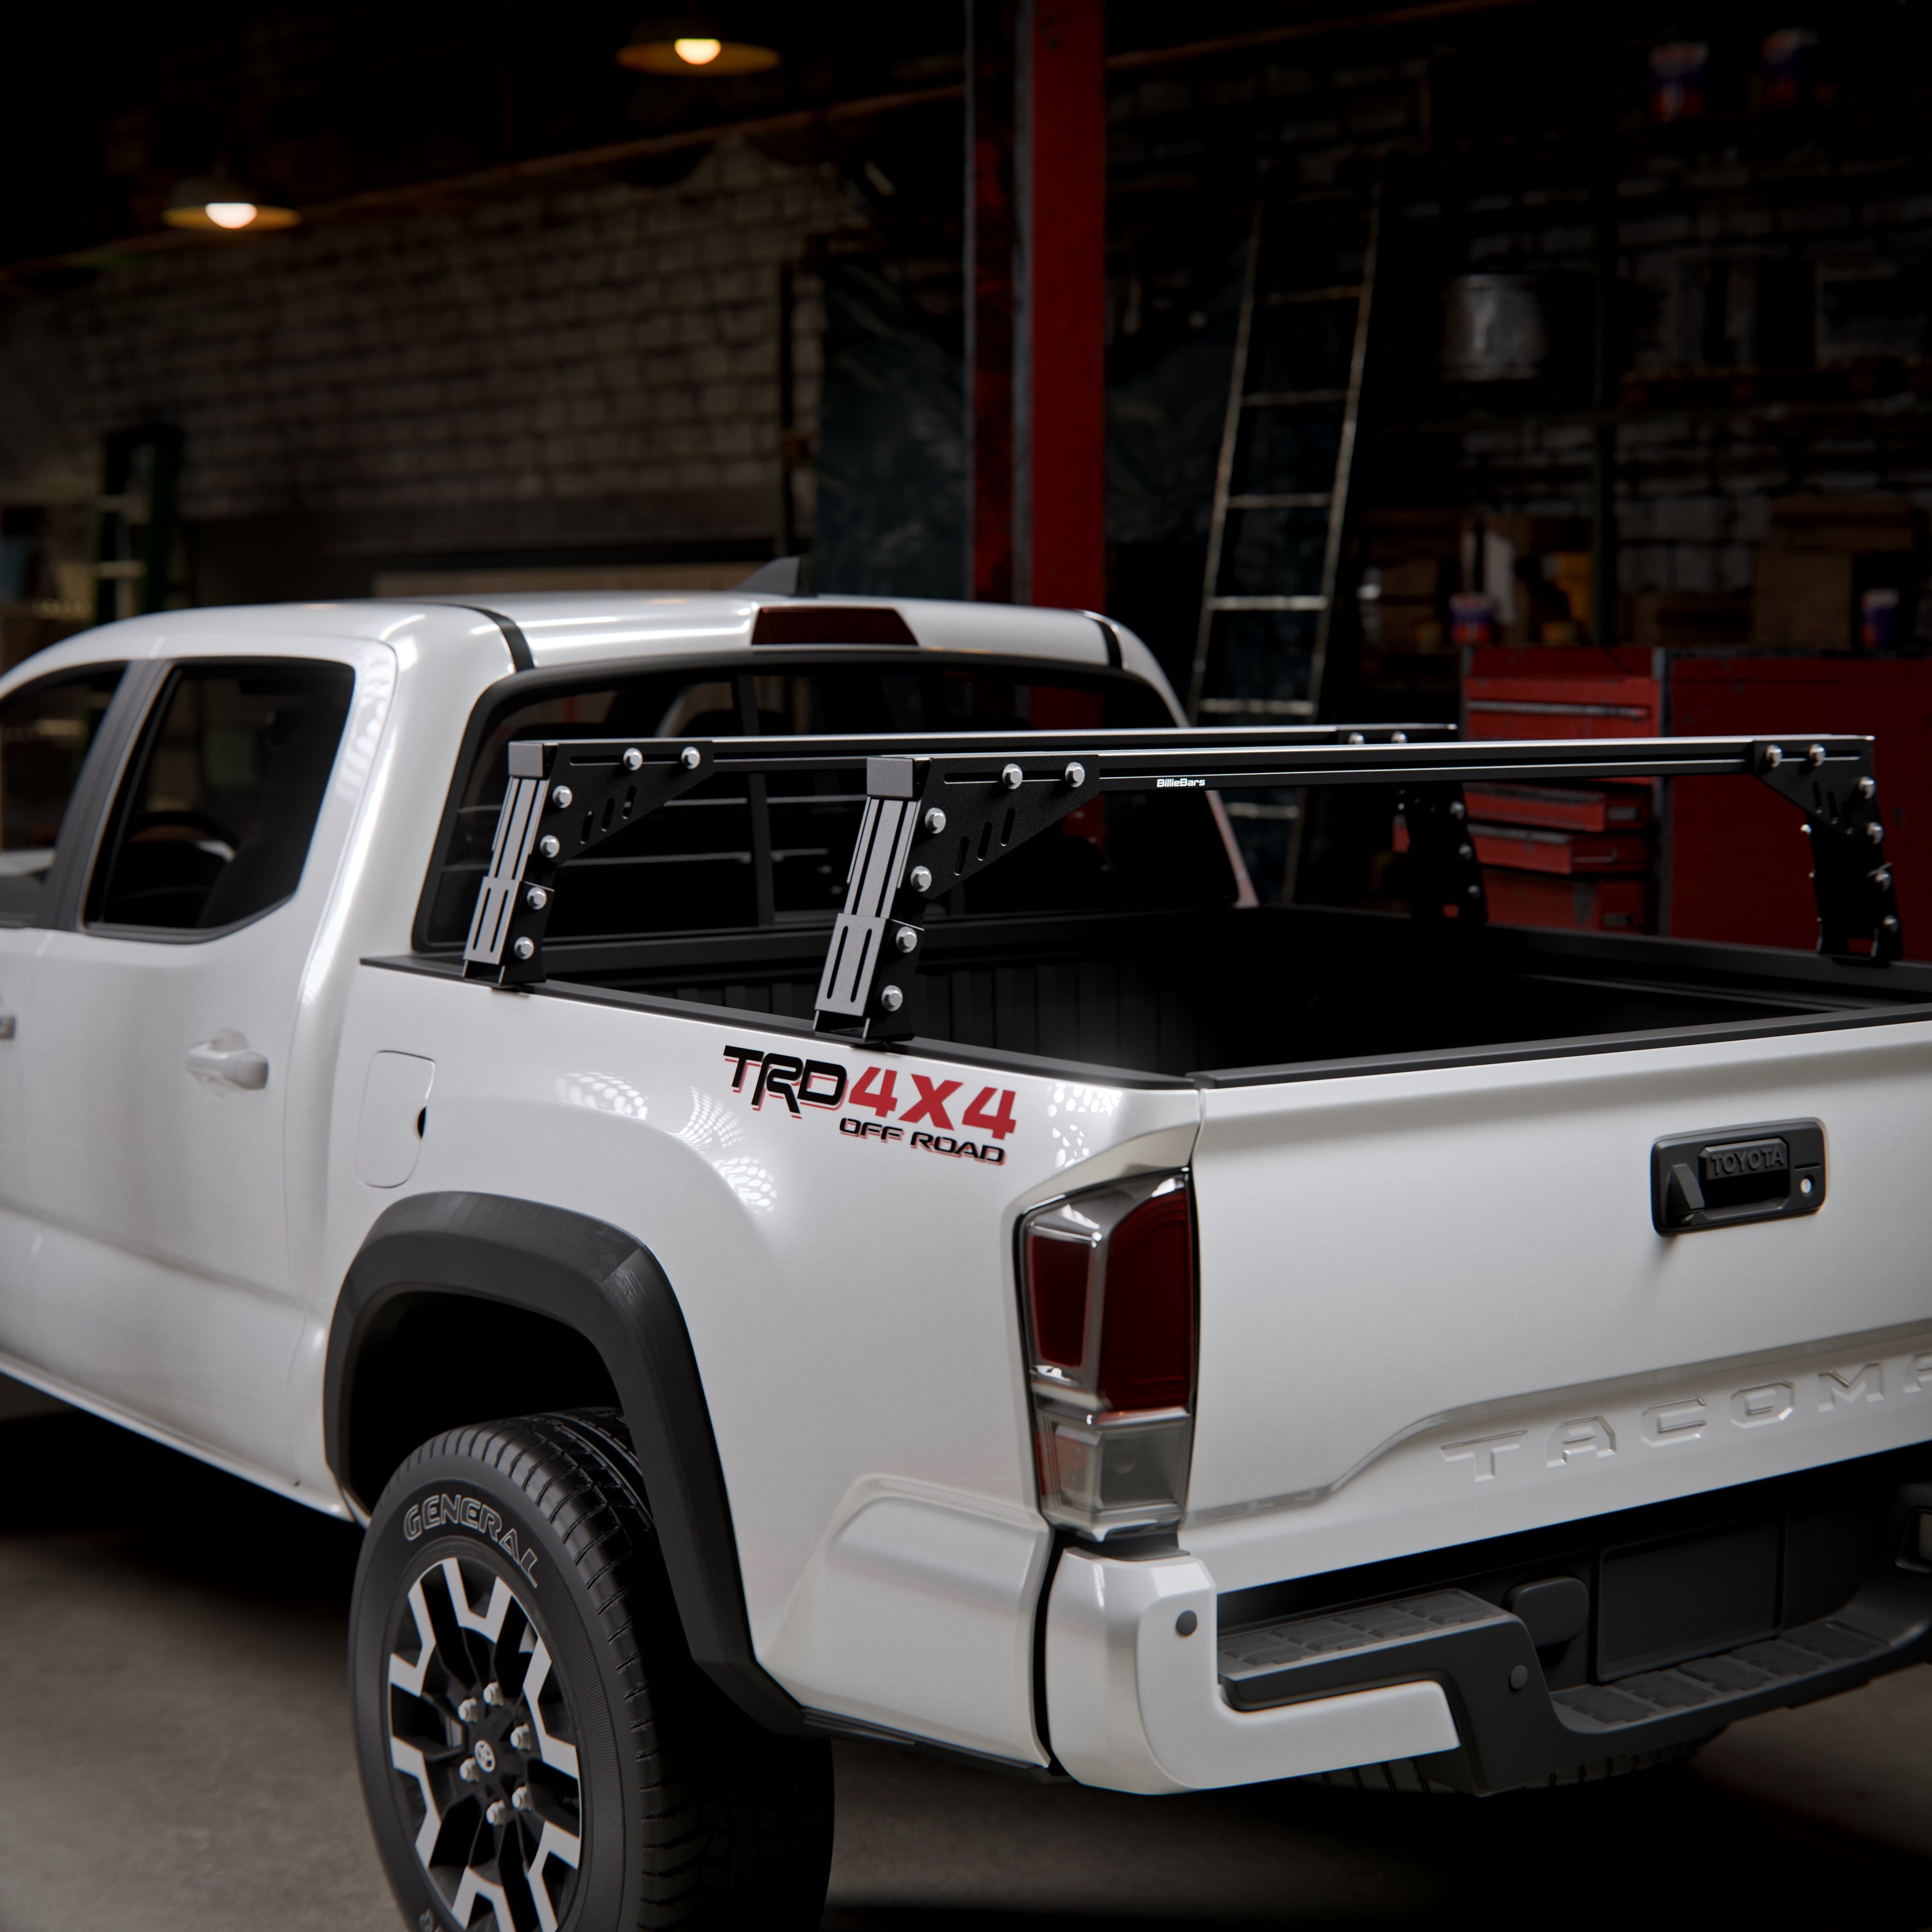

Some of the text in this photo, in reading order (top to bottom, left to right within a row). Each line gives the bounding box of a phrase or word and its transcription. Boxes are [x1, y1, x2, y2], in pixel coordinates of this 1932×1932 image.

[1156, 778, 1206, 788] BillieBars
[723, 1045, 1017, 1140] TRD 4X4
[839, 1117, 1006, 1166] OFF ROAD
[1710, 1146, 1785, 1176] TOYOTA
[403, 1493, 538, 1589] GENERAL
